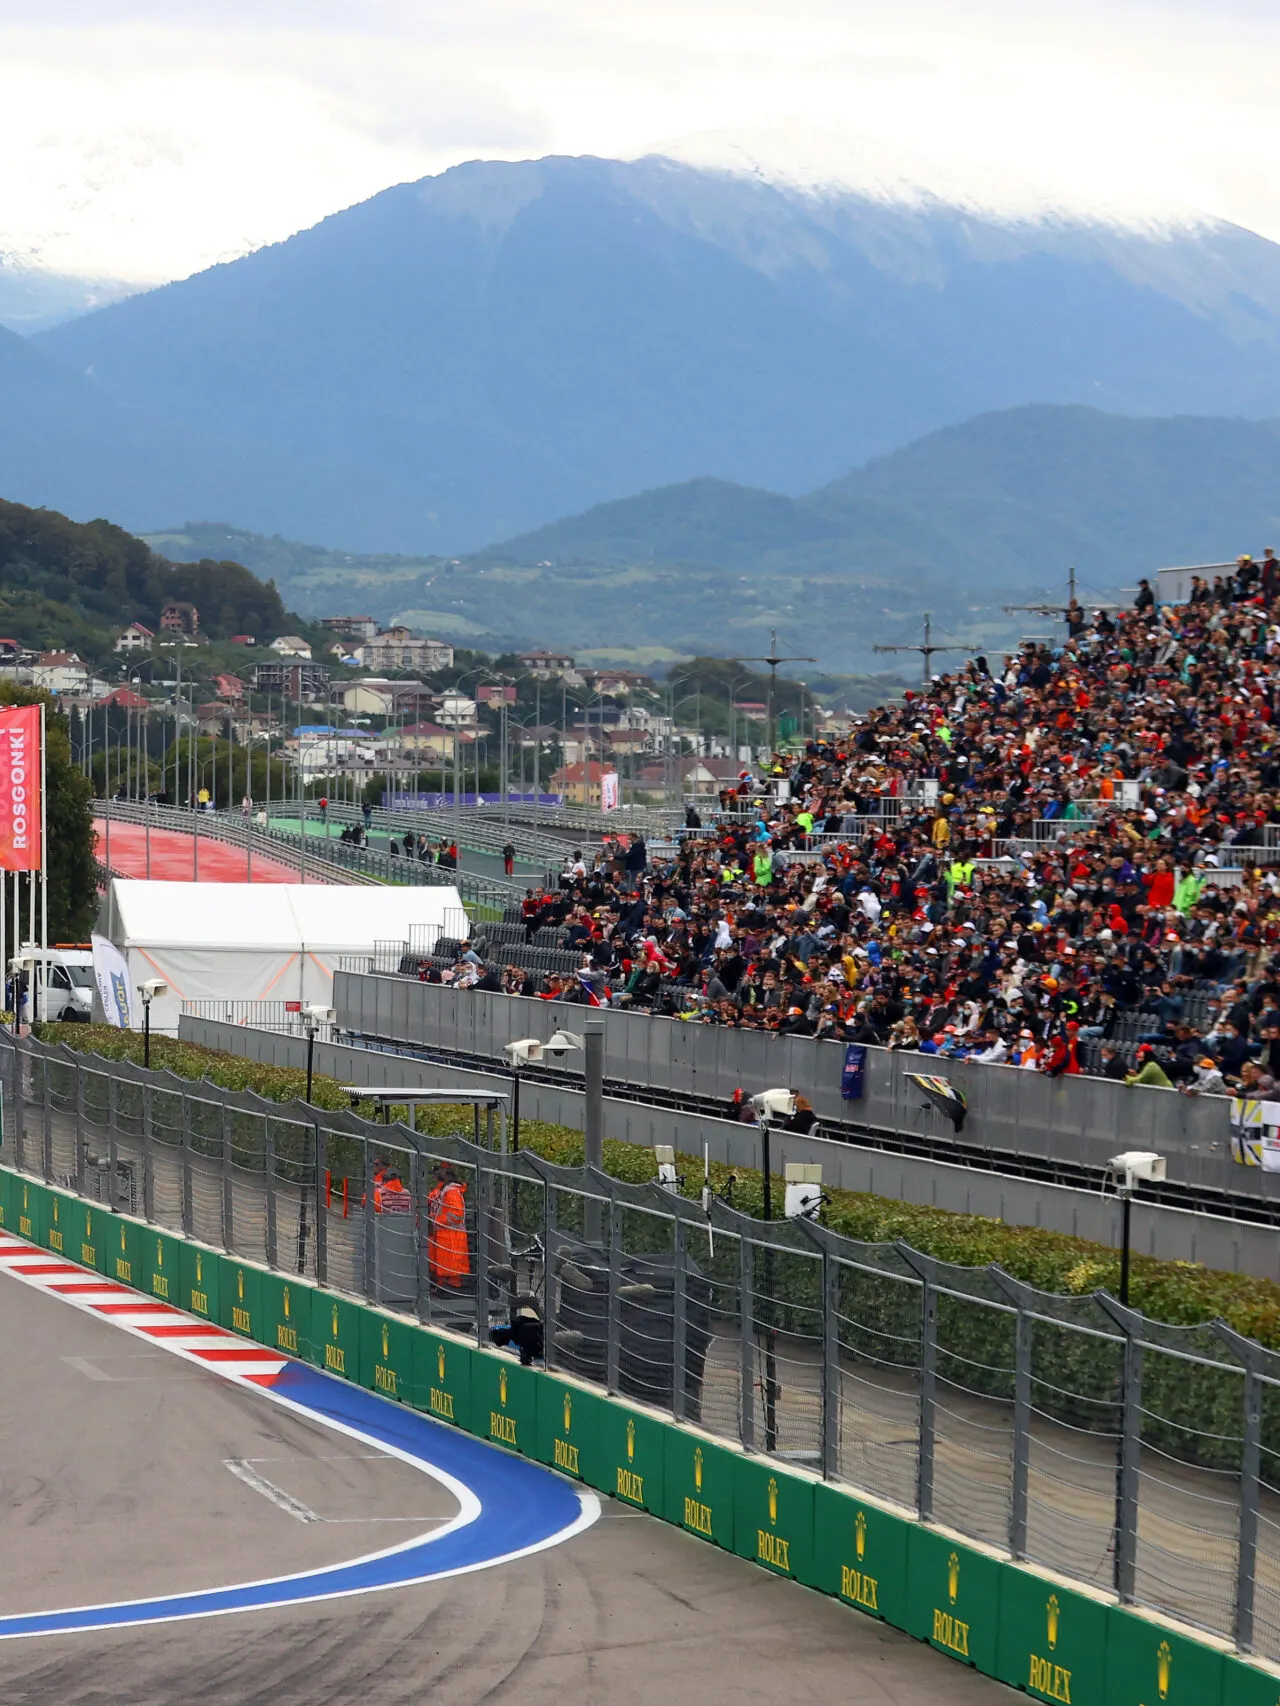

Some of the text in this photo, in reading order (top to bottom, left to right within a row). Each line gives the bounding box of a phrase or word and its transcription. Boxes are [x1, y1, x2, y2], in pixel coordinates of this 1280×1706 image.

[10, 728, 26, 848] ROSGONKI
[430, 1387, 454, 1419] ROLEX
[490, 1411, 517, 1445] ROLEX
[554, 1438, 580, 1474] ROLEX
[616, 1467, 644, 1504] ROLEX
[684, 1496, 713, 1536] ROLEX
[757, 1529, 791, 1572] ROLEX
[841, 1564, 879, 1611] ROLEX
[932, 1607, 970, 1657] ROLEX
[1028, 1653, 1072, 1705] ROLEX
